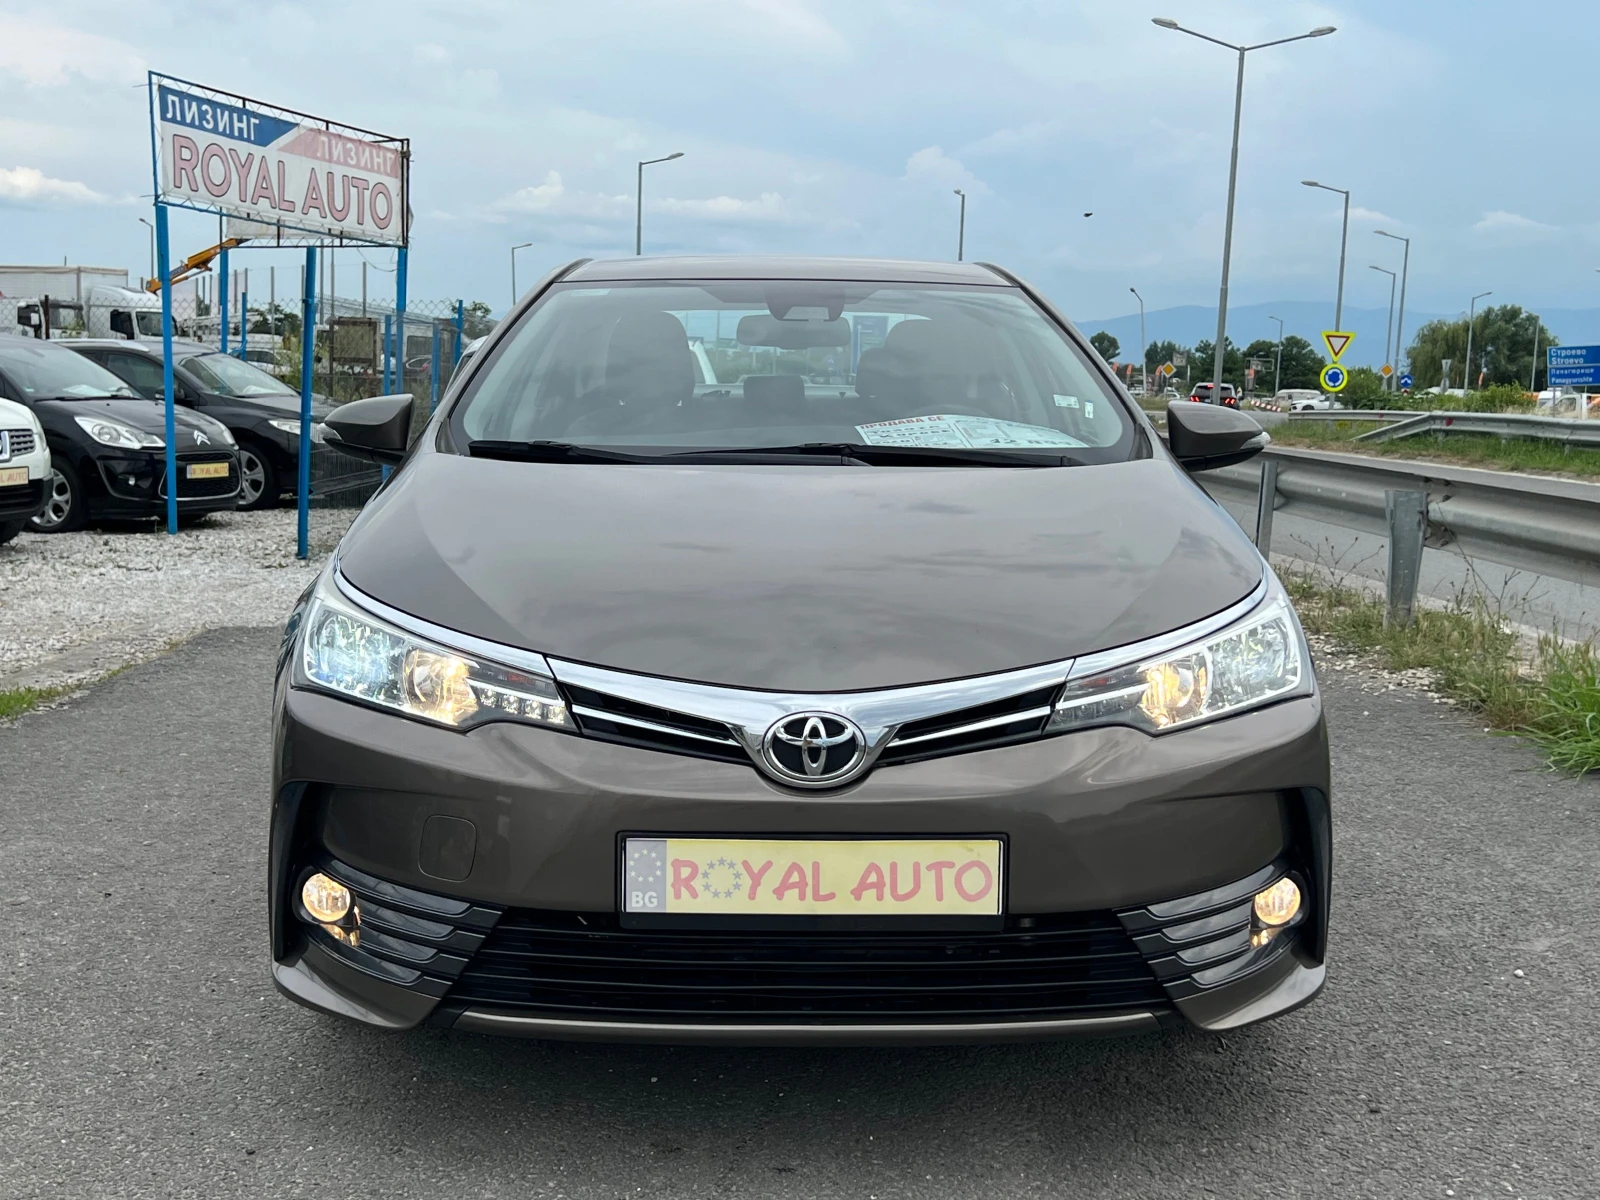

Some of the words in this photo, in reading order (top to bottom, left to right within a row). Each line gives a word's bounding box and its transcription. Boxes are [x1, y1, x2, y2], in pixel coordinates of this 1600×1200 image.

[166, 94, 259, 141] ЛИЗИНГ
[317, 136, 395, 174] ЛИЗИНГ
[172, 133, 295, 212] ROYAL
[302, 167, 393, 230] AUTO
[1551, 349, 1587, 357] Строево
[1551, 357, 1584, 365] Stroevo
[670, 857, 836, 902] ROYAL
[850, 860, 993, 902] AUTO
[631, 891, 658, 908] BG
